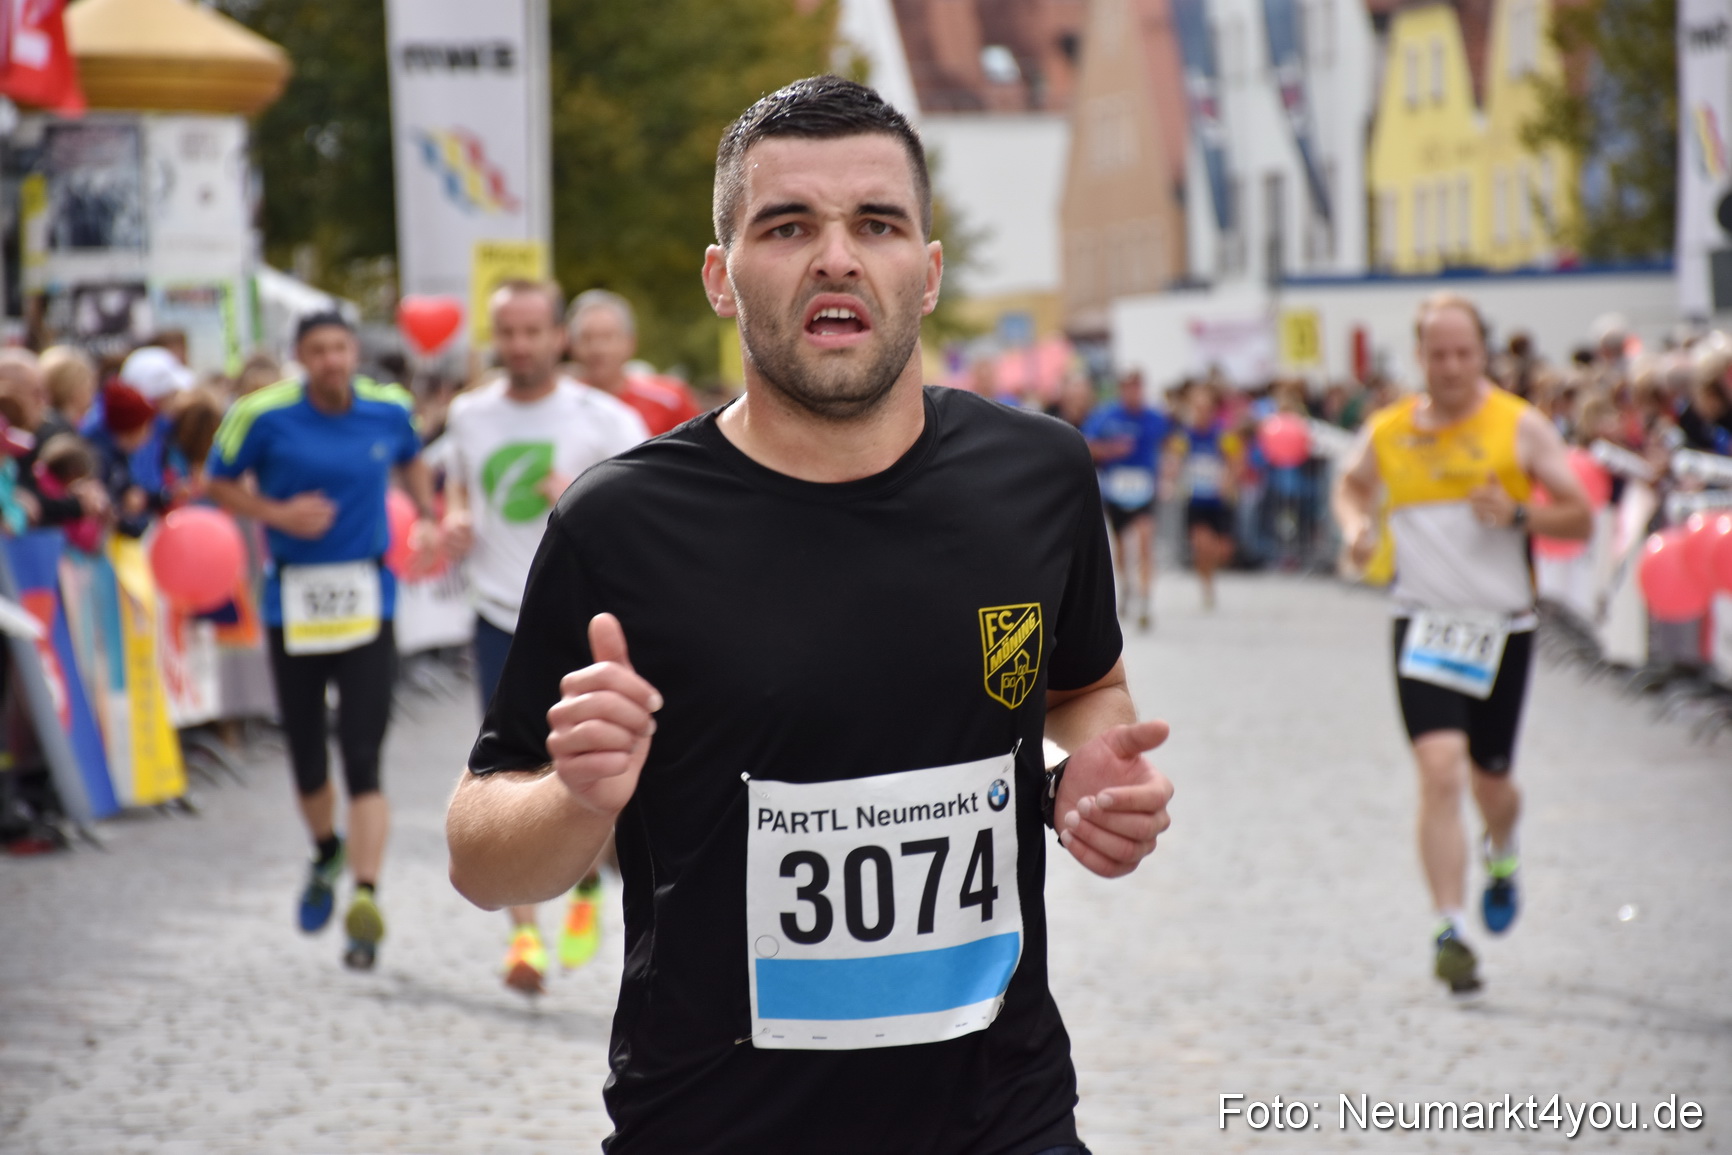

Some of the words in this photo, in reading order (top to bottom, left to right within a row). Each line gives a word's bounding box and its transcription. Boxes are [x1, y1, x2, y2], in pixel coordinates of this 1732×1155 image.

[985, 610, 1015, 649] FC
[990, 611, 1036, 672] MÖNING
[757, 807, 848, 834] PARTL
[857, 792, 979, 827] Neumarkt
[779, 827, 998, 945] 3074
